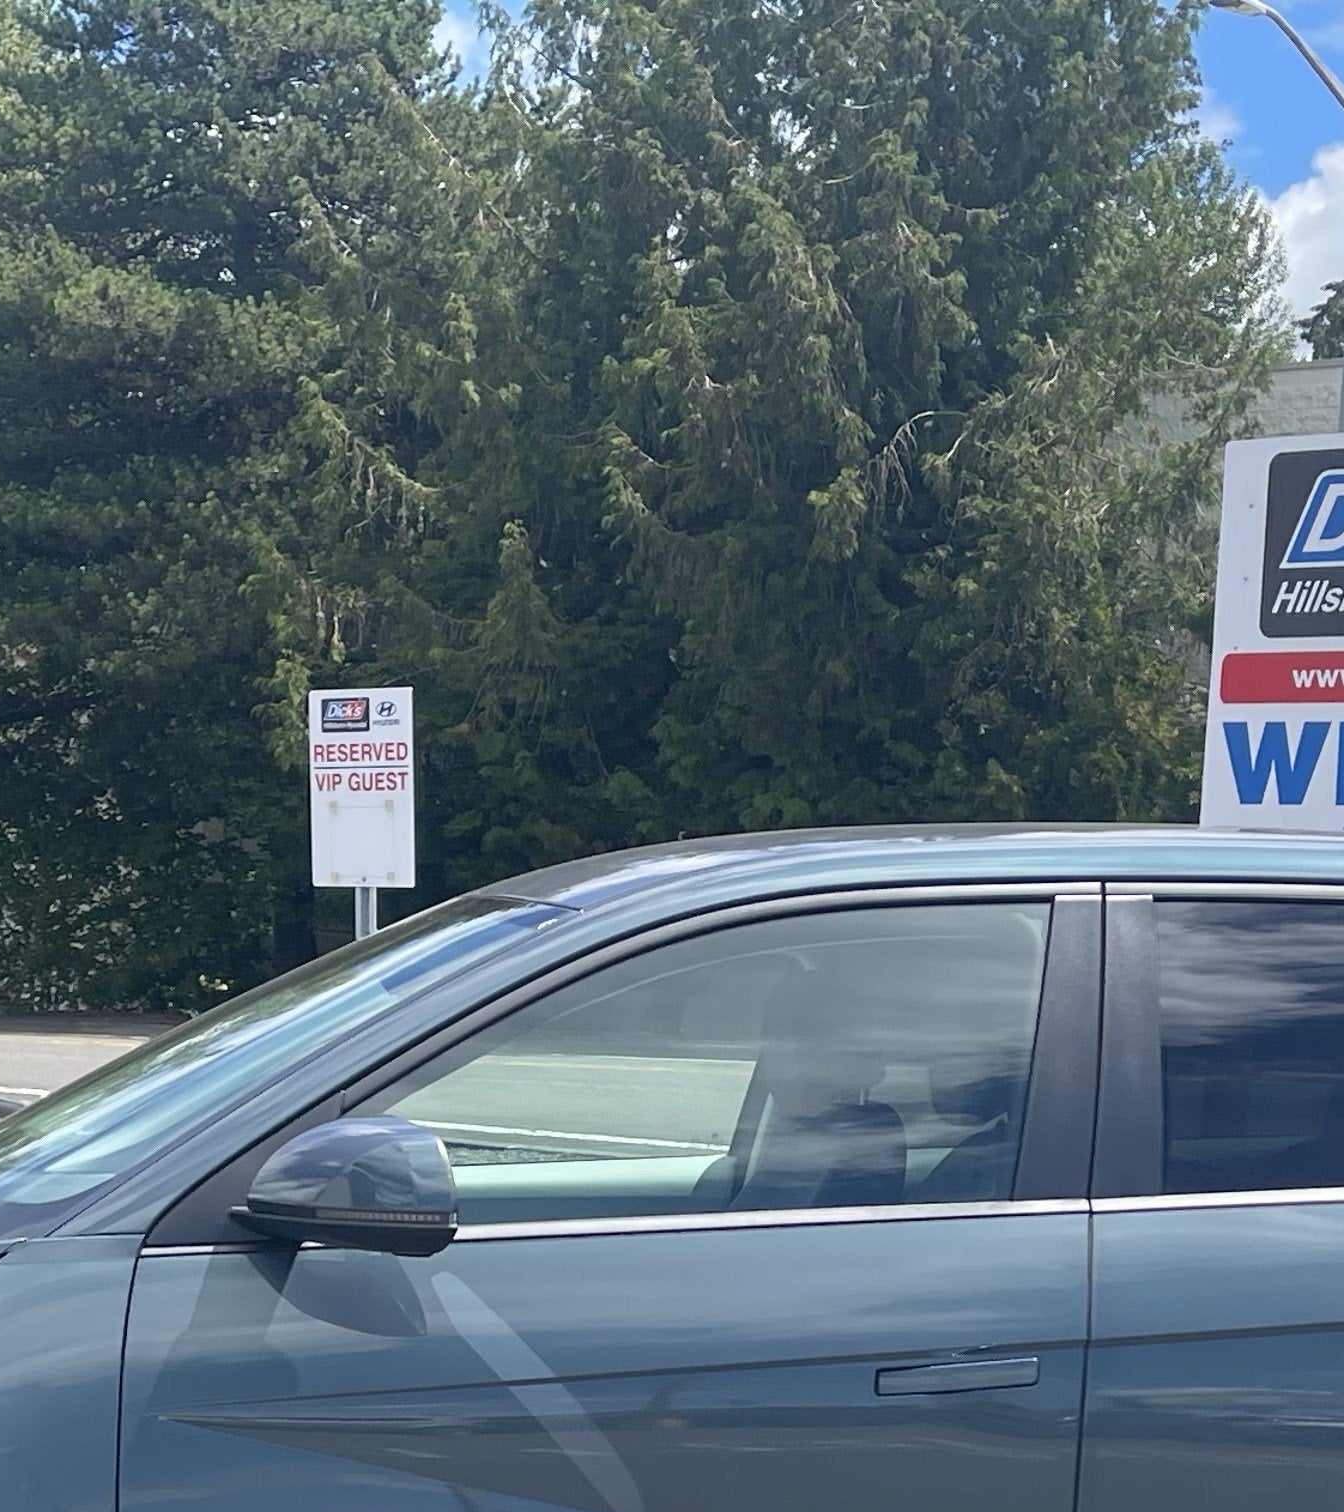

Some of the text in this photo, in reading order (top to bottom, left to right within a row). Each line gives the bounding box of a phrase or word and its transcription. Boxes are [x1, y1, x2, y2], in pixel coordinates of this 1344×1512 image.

[314, 742, 408, 762] RESERVED
[315, 772, 409, 792] VIP GUEST
